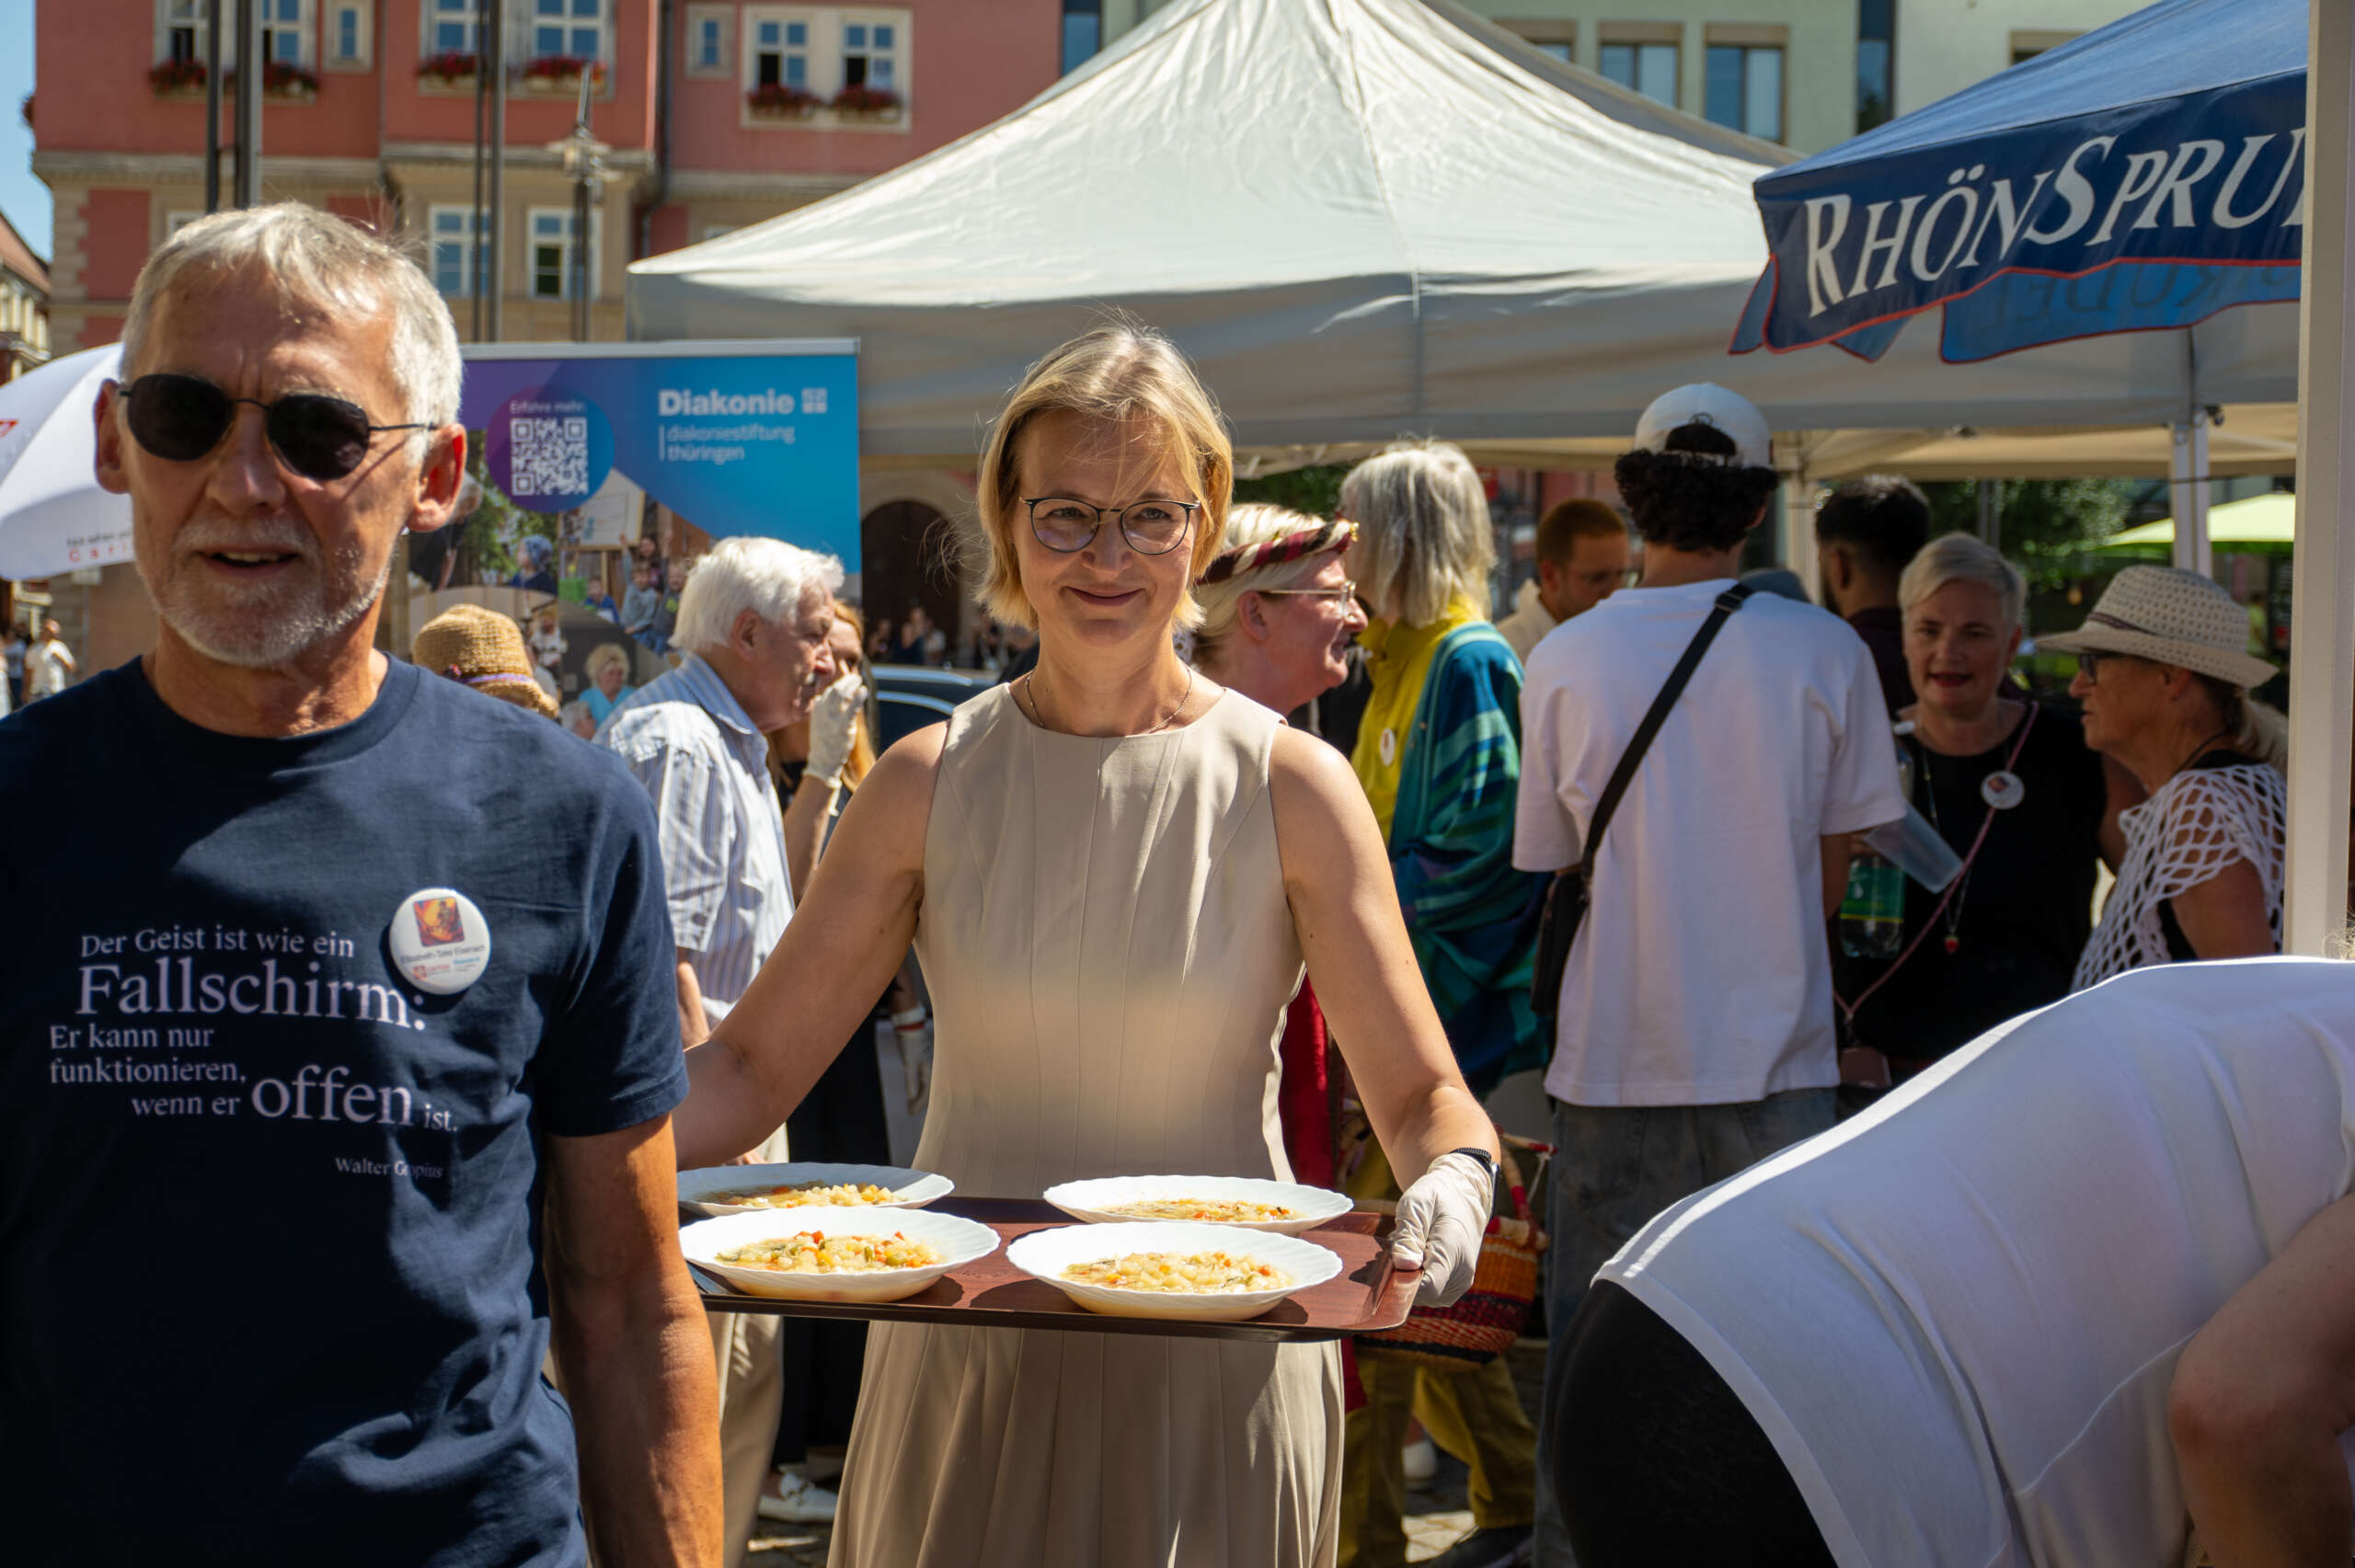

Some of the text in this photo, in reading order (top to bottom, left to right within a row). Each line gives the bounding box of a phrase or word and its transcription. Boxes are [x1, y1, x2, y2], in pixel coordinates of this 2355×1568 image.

[658, 388, 796, 416] Diakonie
[667, 423, 797, 444] diakoniestiftung
[667, 444, 746, 465] thüringen
[81, 923, 354, 957] Der Geist ist wie ein
[75, 956, 426, 1030] Fallschirm:
[50, 1023, 214, 1049] Er kann nur
[50, 1057, 247, 1084] funktionieren,
[132, 1064, 459, 1132] wenn er offen ist.
[335, 1157, 390, 1175] Walter
